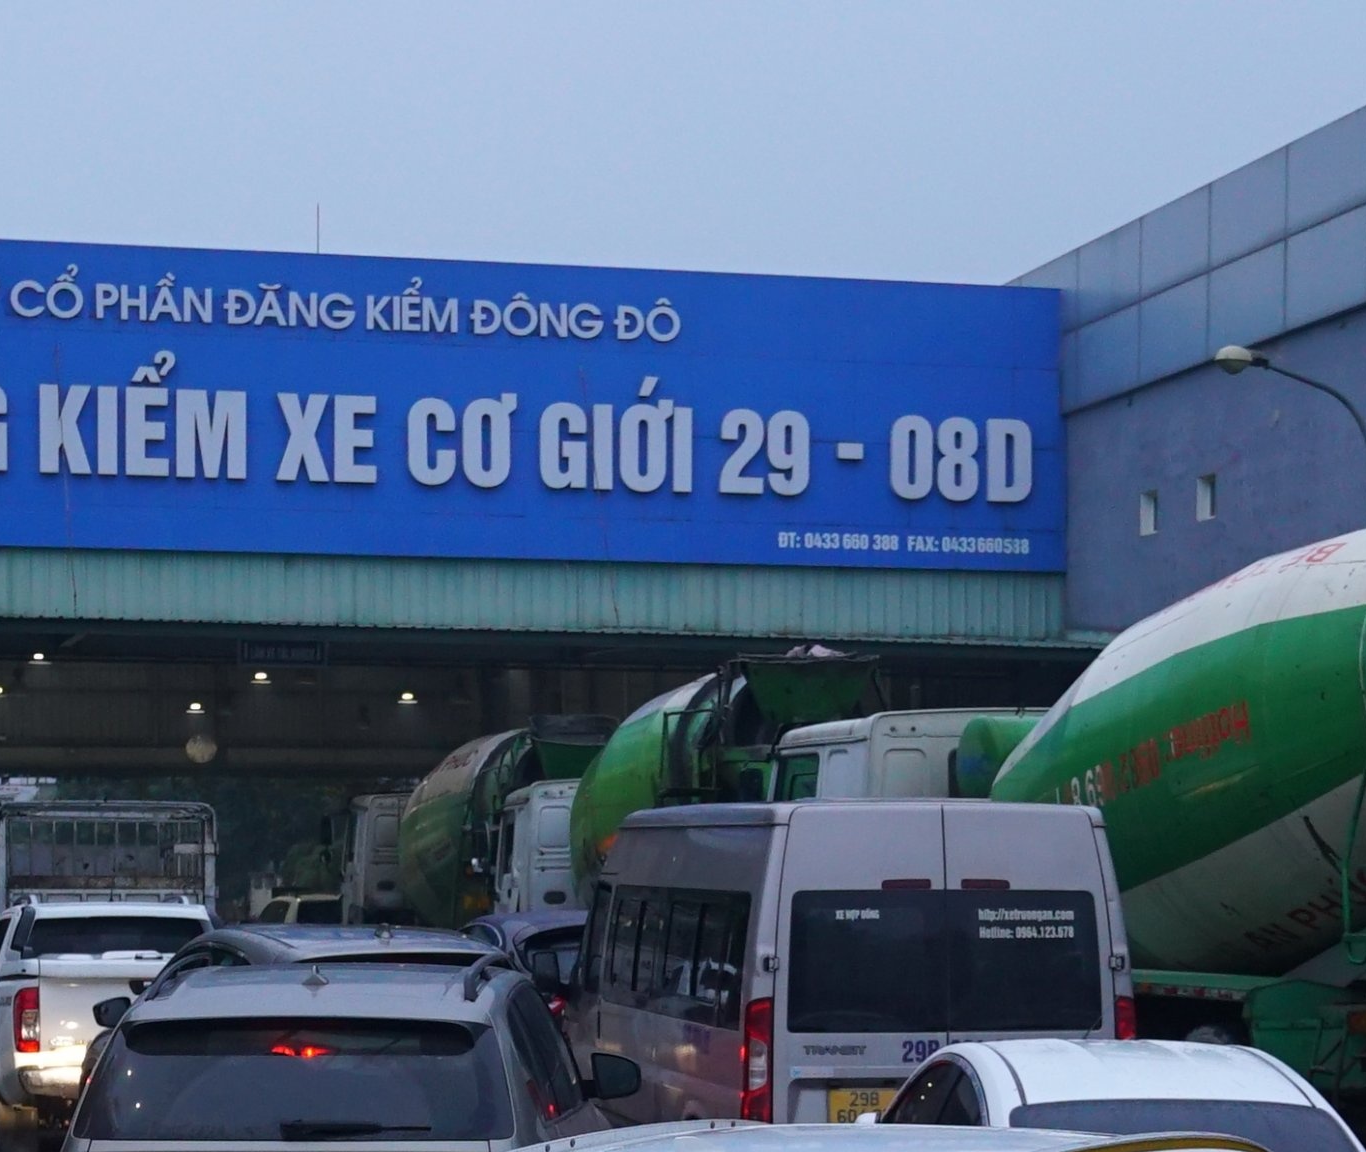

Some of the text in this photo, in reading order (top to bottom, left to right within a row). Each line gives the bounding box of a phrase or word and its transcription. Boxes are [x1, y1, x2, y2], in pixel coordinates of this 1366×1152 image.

[10, 263, 84, 320] CỔ
[95, 271, 214, 325] PHẦN
[223, 282, 355, 331] ĐĂNG
[366, 276, 459, 335] KIỂM
[471, 292, 604, 341] ĐÔNG
[614, 299, 681, 343] ĐÔ
[40, 350, 248, 480] KIỂM
[276, 391, 378, 485] XE
[407, 392, 518, 489] CƠ
[539, 376, 694, 495] GIỚI
[719, 409, 811, 497] 29
[838, 442, 865, 461] -
[889, 414, 1034, 504] 08D
[804, 532, 840, 550] 0433
[842, 533, 868, 550] 660
[907, 535, 940, 553] FAX:
[979, 926, 1014, 938] Hotline:
[850, 1092, 880, 1107] 29B
